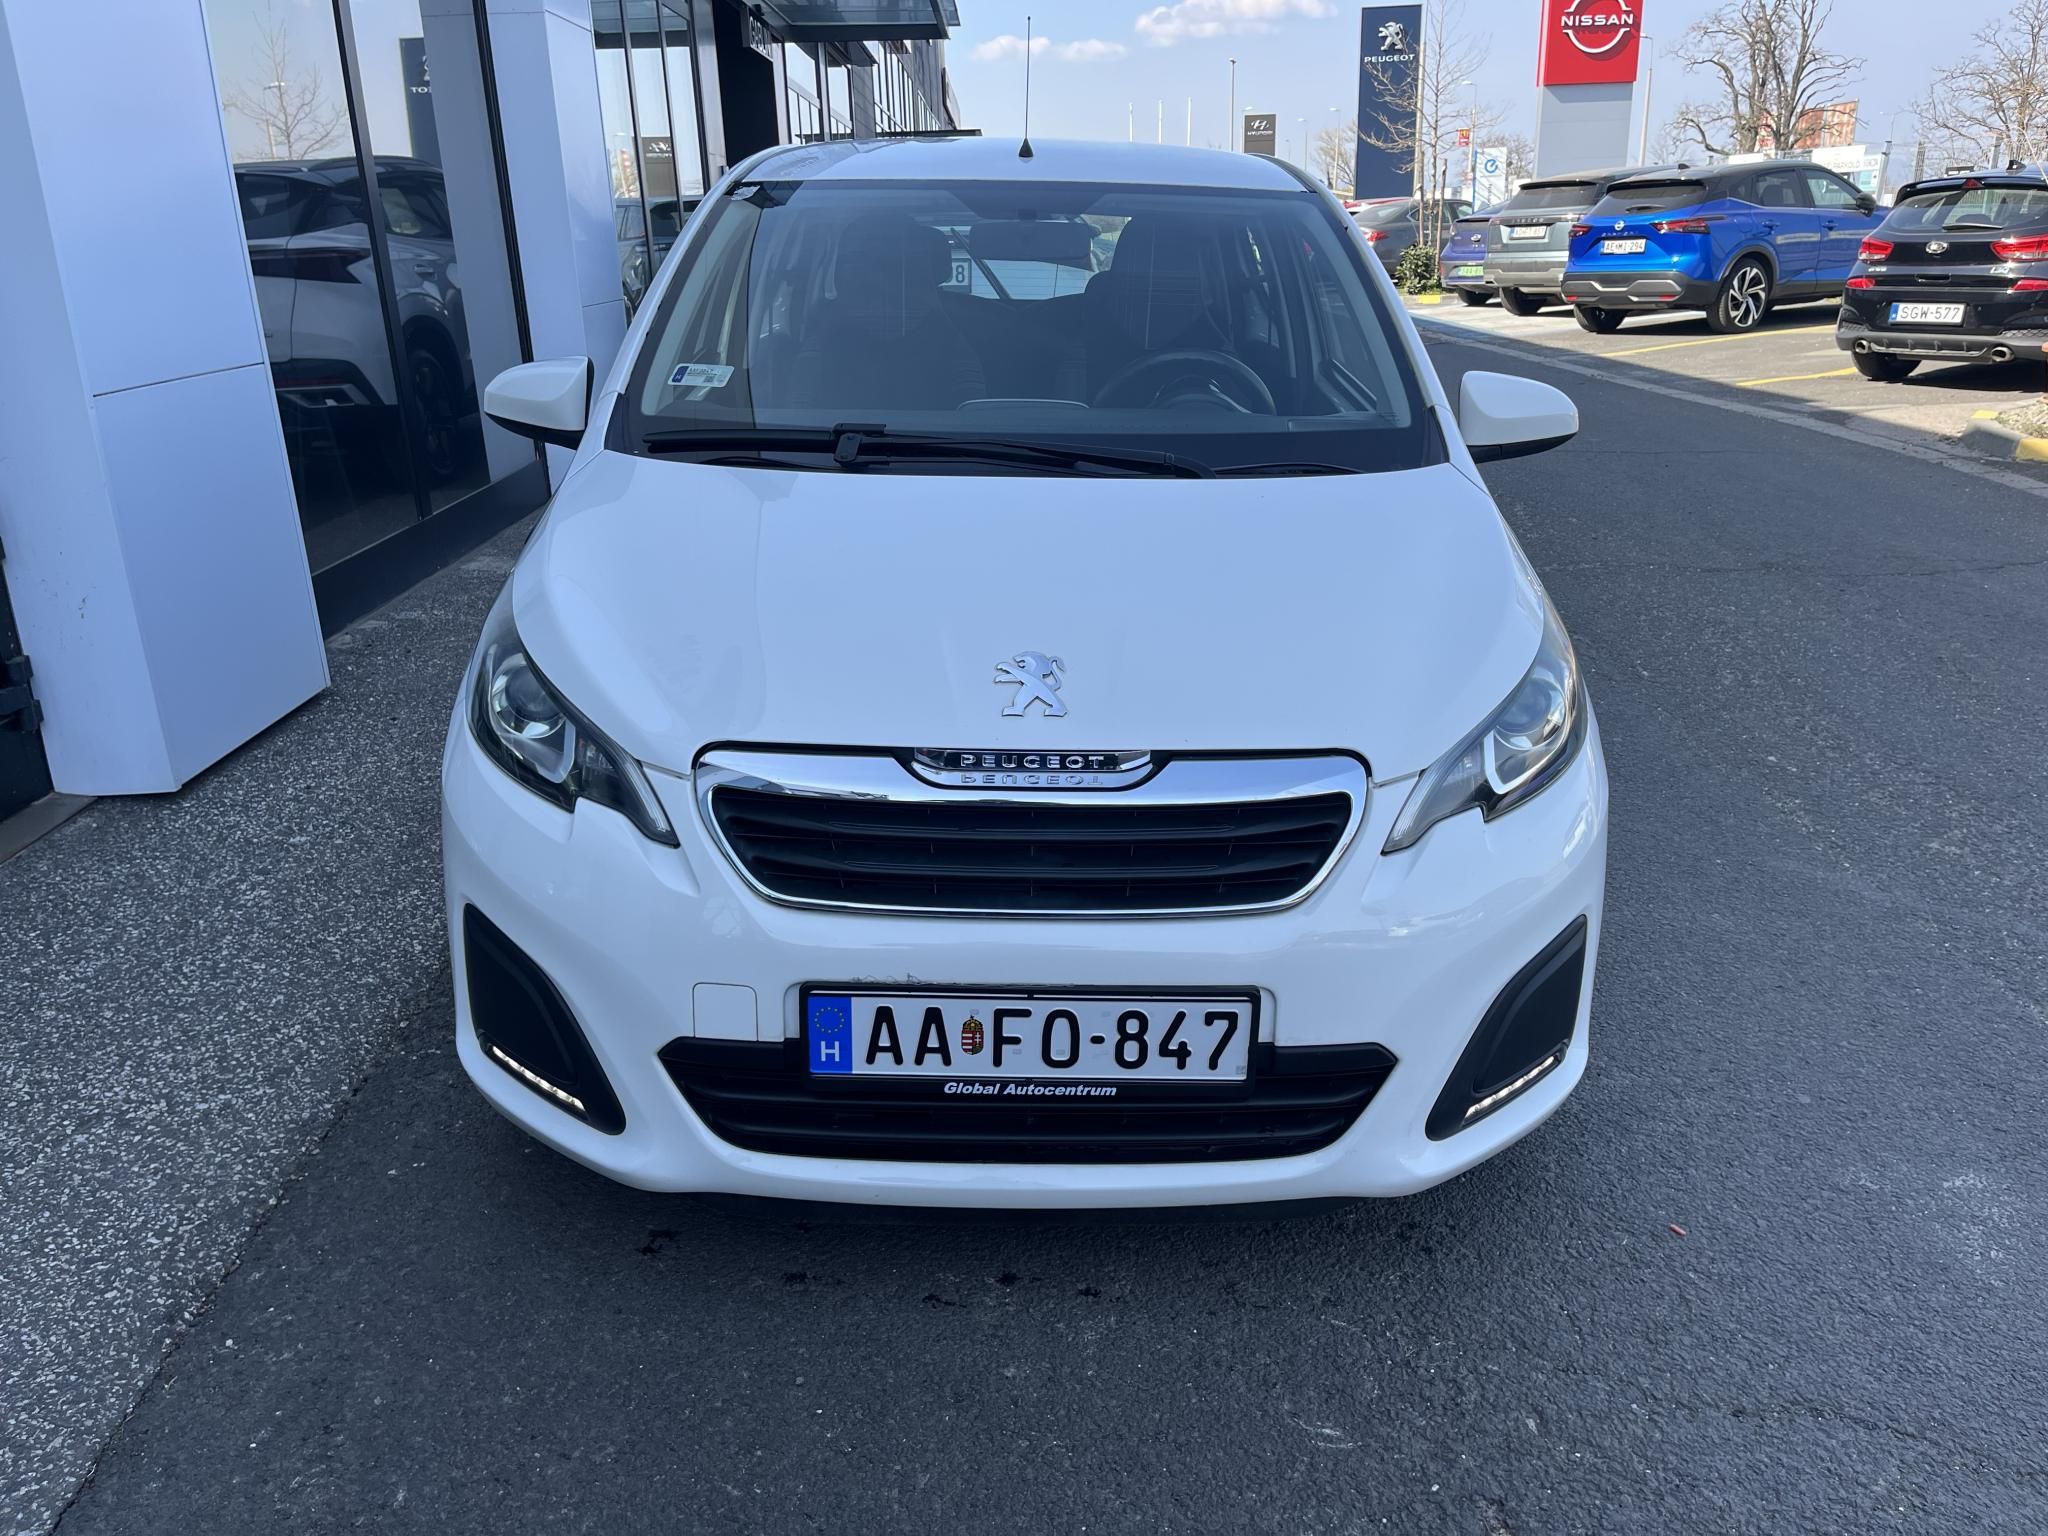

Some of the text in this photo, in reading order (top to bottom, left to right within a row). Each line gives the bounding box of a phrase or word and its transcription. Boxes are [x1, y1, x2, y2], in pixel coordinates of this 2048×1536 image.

[1561, 13, 1634, 27] NISSAN
[1364, 53, 1416, 63] PEUGEOT
[1900, 306, 1961, 320] SGW-577
[960, 754, 1105, 769] PEUGEOT
[820, 1040, 840, 1062] H
[865, 1005, 952, 1066] AA
[943, 1082, 1117, 1097] Global Autocentrum
